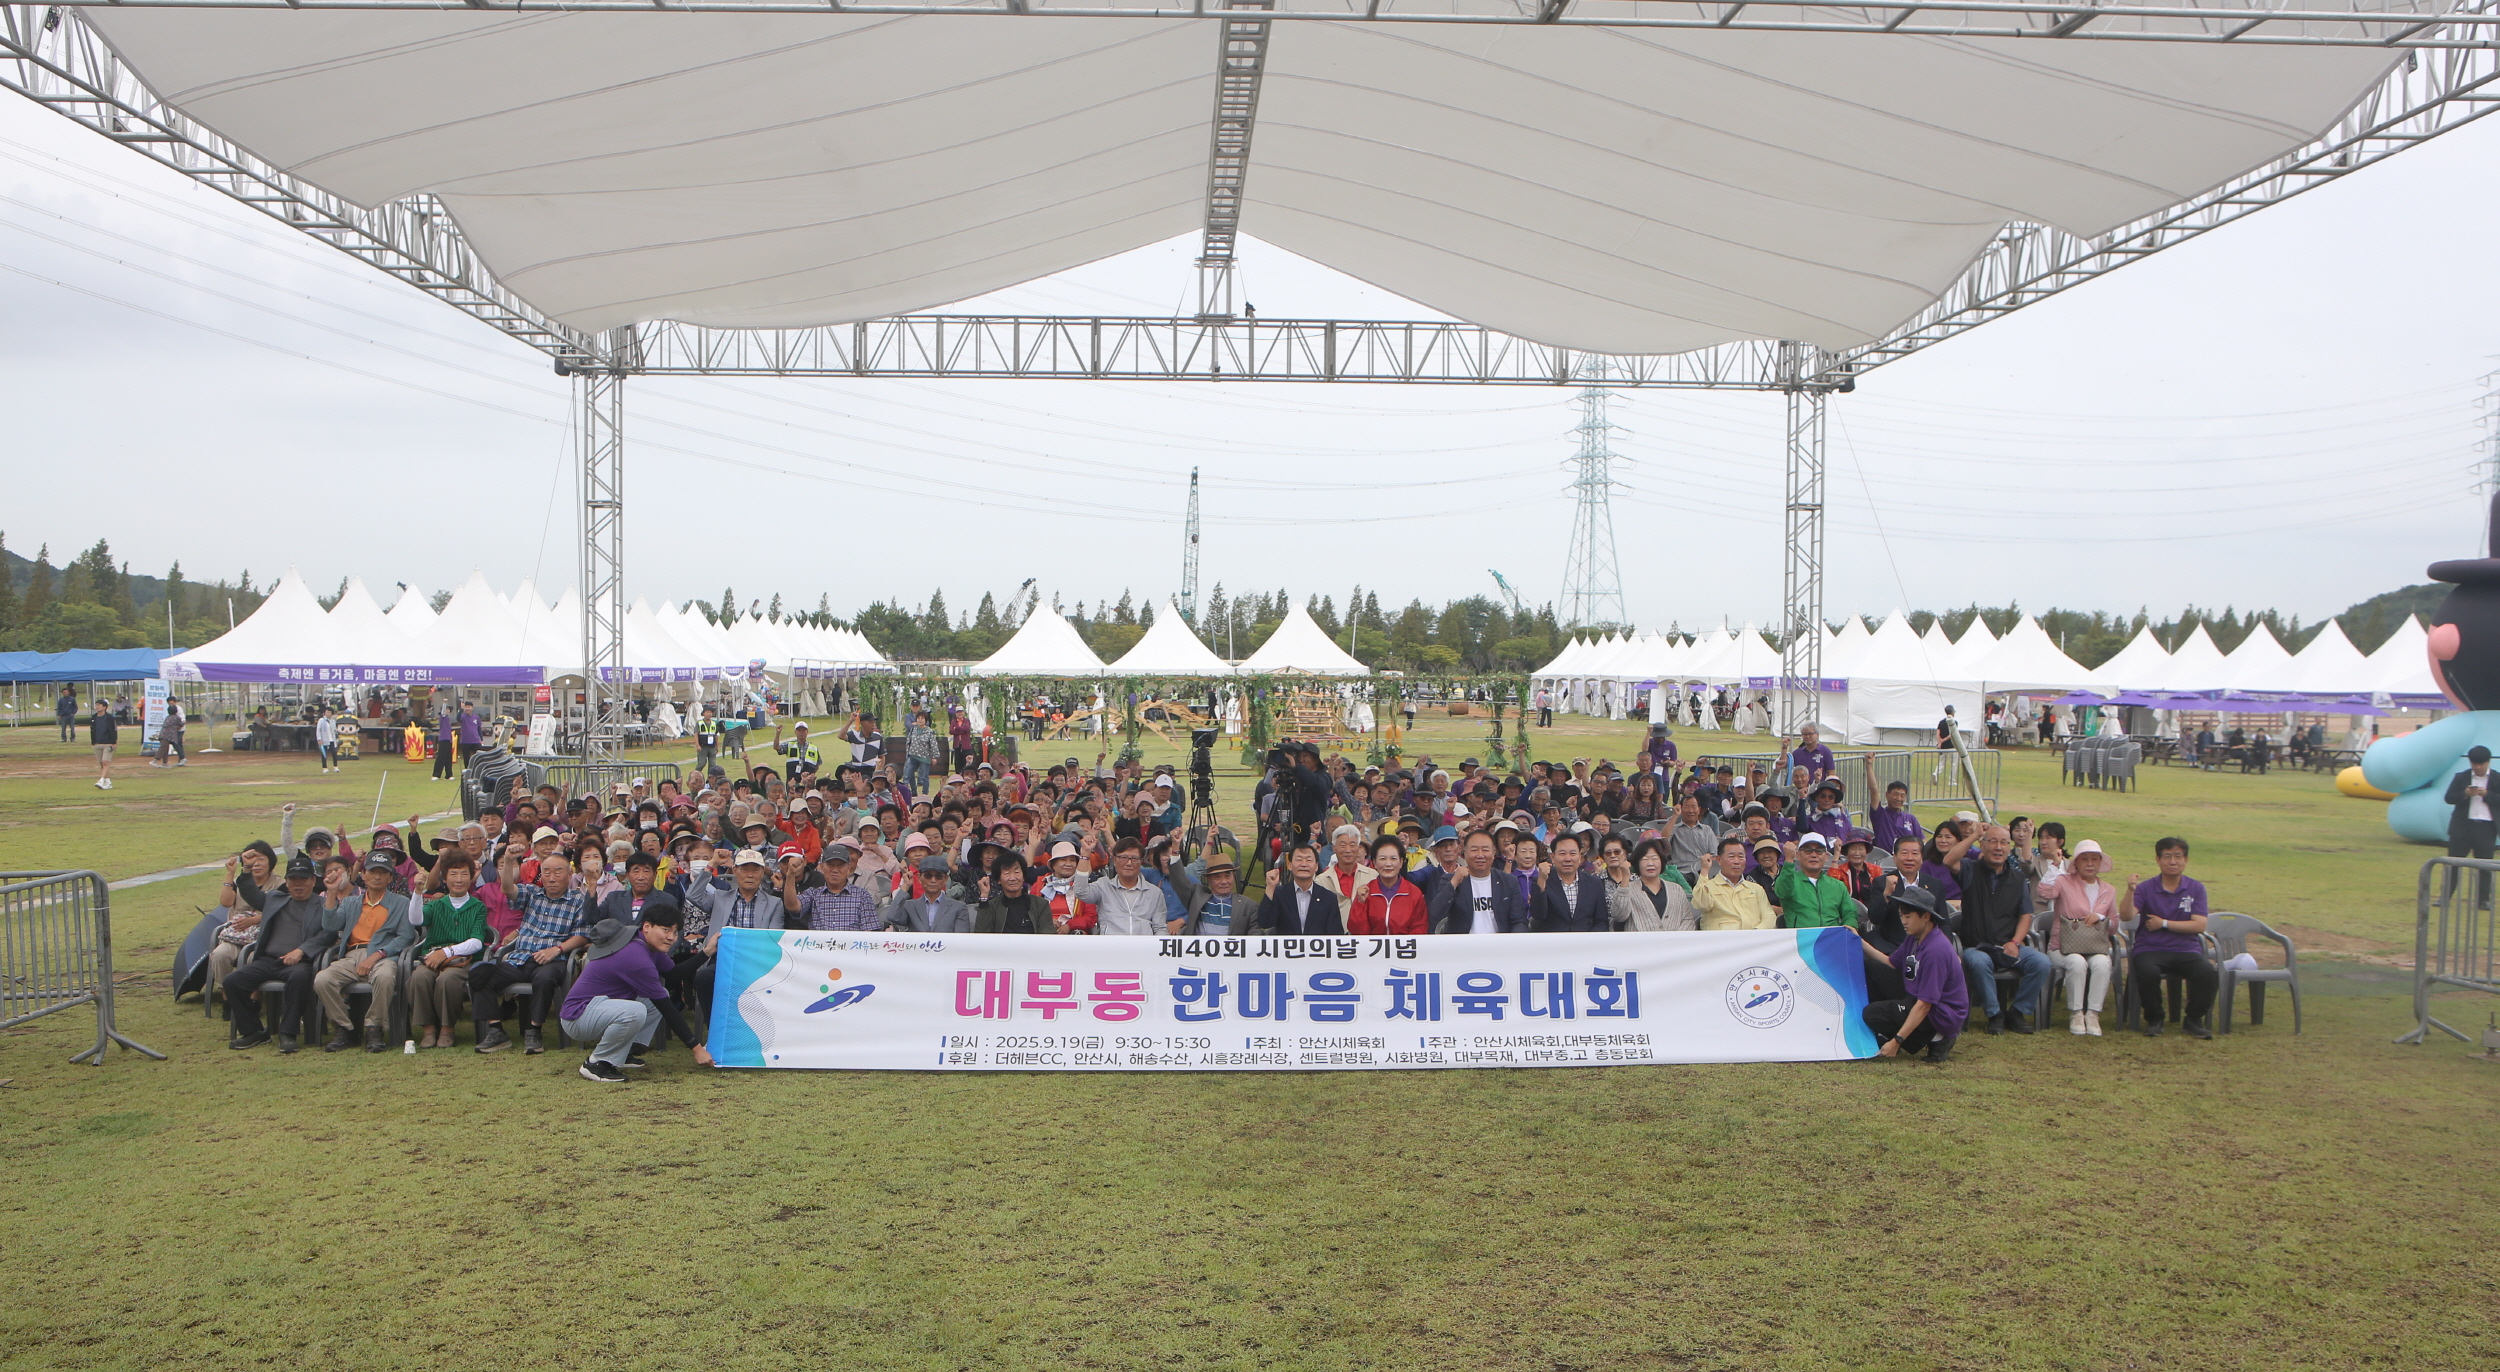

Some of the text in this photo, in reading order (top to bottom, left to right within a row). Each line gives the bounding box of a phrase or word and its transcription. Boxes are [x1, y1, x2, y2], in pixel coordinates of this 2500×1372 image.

[279, 668, 314, 680] 축제엔
[319, 668, 359, 681] 즐거움,
[364, 669, 399, 681] 마음엔
[404, 669, 432, 681] 안전!
[794, 936, 825, 953] 시민과
[850, 941, 880, 955] 자유로운
[882, 940, 917, 955] 혁신도시
[919, 940, 947, 952] 안산
[1159, 938, 1418, 960] 제40회 시민의날 기념
[1728, 969, 1791, 992] 안산시체육회
[954, 965, 1640, 1023] 대부동 한마음 체육대회
[1730, 999, 1792, 1026] ANSAN CITY SPORTS COUNCIL
[950, 1036, 979, 1048] 일시
[995, 1036, 1104, 1049] 2025.9.19(금)
[1115, 1036, 1211, 1049] 9:30~15:30
[1253, 1037, 1282, 1049] 주최
[1299, 1036, 1385, 1049] 안산시체육회
[1428, 1036, 1457, 1048] 주관
[948, 1052, 977, 1065] 후원
[995, 1052, 1066, 1067] 더헤븐CC,
[1074, 1052, 1122, 1067] 안산시,
[1129, 1052, 1195, 1067] 해송수산,
[1200, 1052, 1293, 1066] 시흥장례식장,
[1299, 1051, 1378, 1066] 센트럴병원,
[1385, 1051, 1449, 1065] 시화병원,
[1454, 1050, 1518, 1064] 대부목재,
[1525, 1049, 1588, 1062] 대부중.고
[1595, 1048, 1654, 1061] 총동문회
